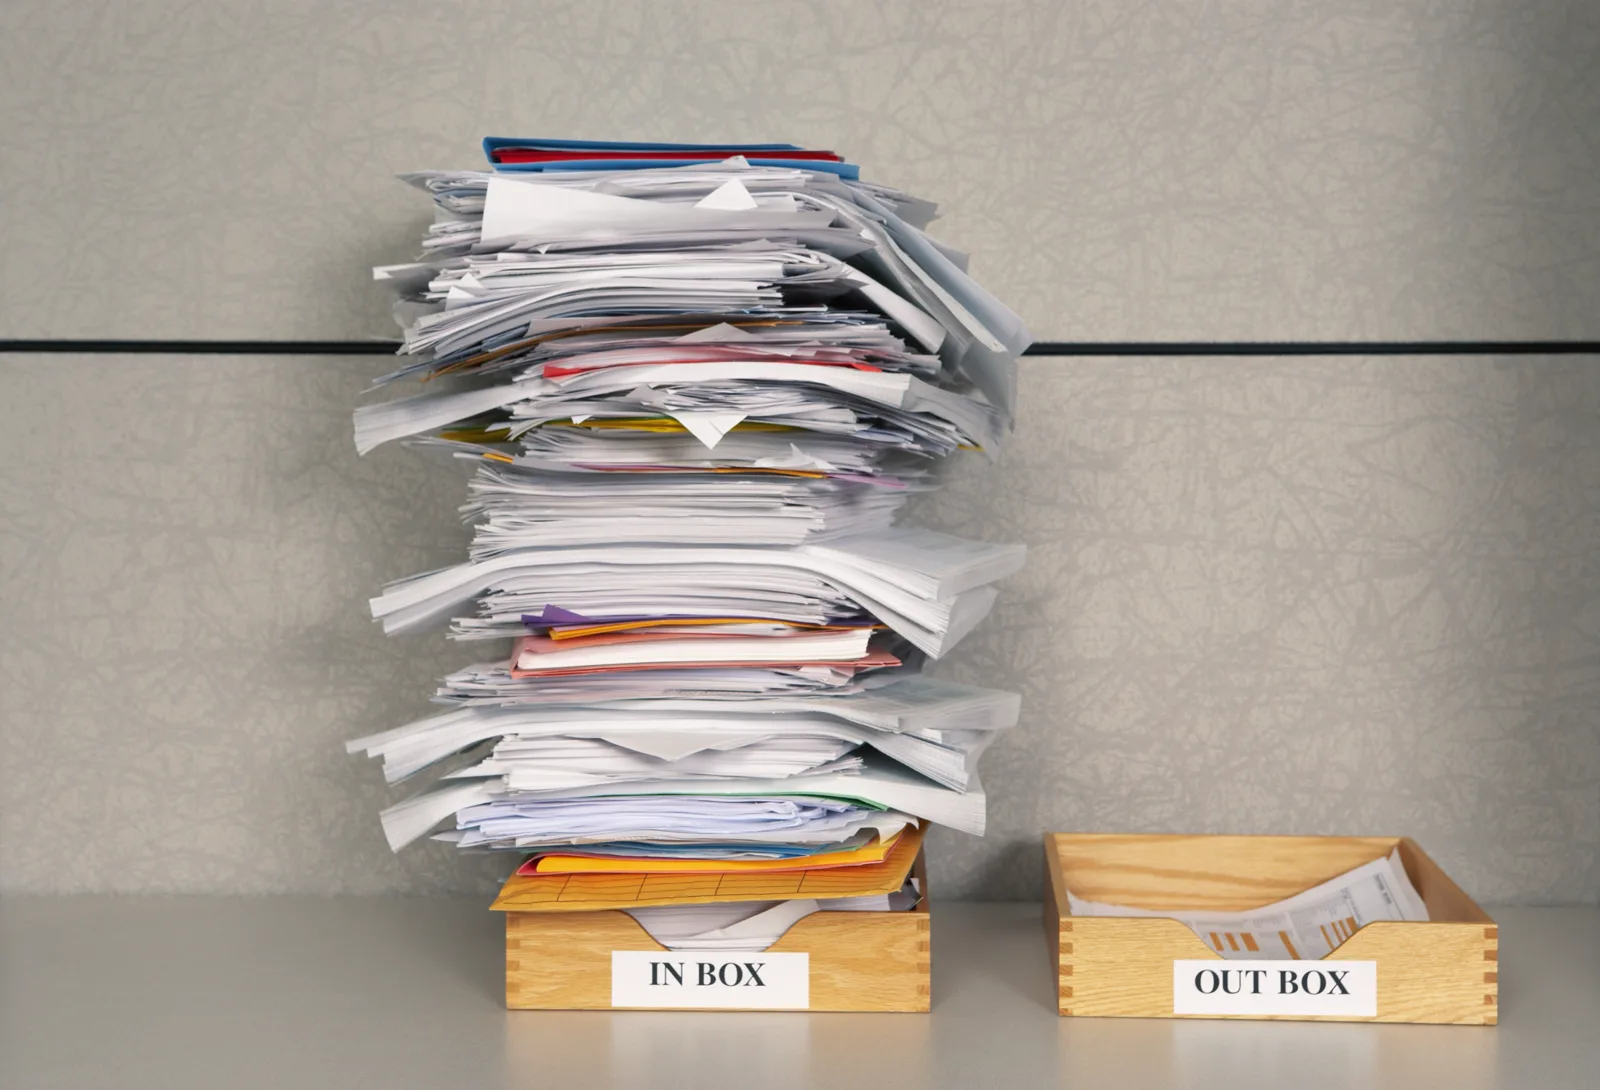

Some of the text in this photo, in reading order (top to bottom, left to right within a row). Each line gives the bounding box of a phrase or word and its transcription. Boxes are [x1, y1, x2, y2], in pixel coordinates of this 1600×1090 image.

[649, 961, 766, 987] IN BOX
[1194, 969, 1350, 995] OUT BOX
